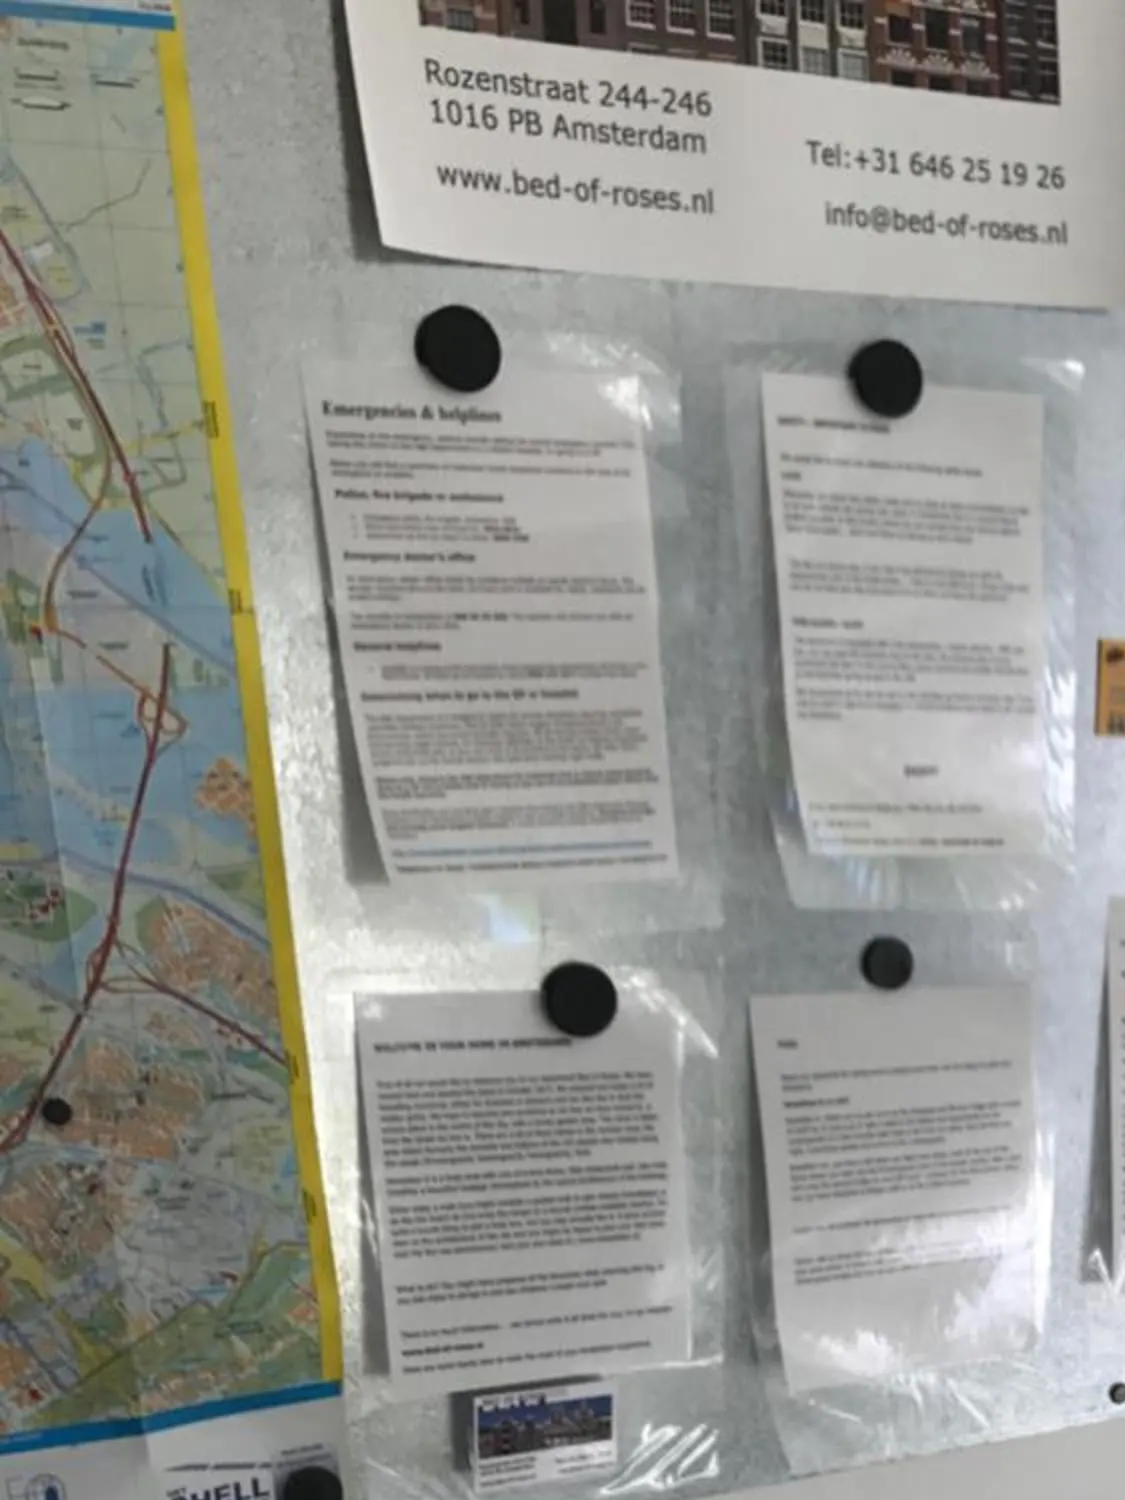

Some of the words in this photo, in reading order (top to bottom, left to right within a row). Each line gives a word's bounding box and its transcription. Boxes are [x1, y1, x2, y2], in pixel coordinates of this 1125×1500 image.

[424, 57, 590, 105] Rozenstraat
[598, 80, 714, 119] 244-246
[429, 99, 499, 131] 1016
[507, 109, 544, 138] PB
[552, 113, 709, 154] Amsterdam
[436, 162, 715, 216] www.bed-of-roses.nl
[806, 140, 901, 177] Tel:+31
[908, 151, 955, 181] 646
[961, 157, 993, 184] 25
[1000, 161, 1029, 188] 19
[1036, 164, 1066, 190] 26
[824, 200, 1069, 247] info@bed-of-roses.nl
[322, 399, 417, 421] Emergencies
[437, 404, 502, 427] helplines
